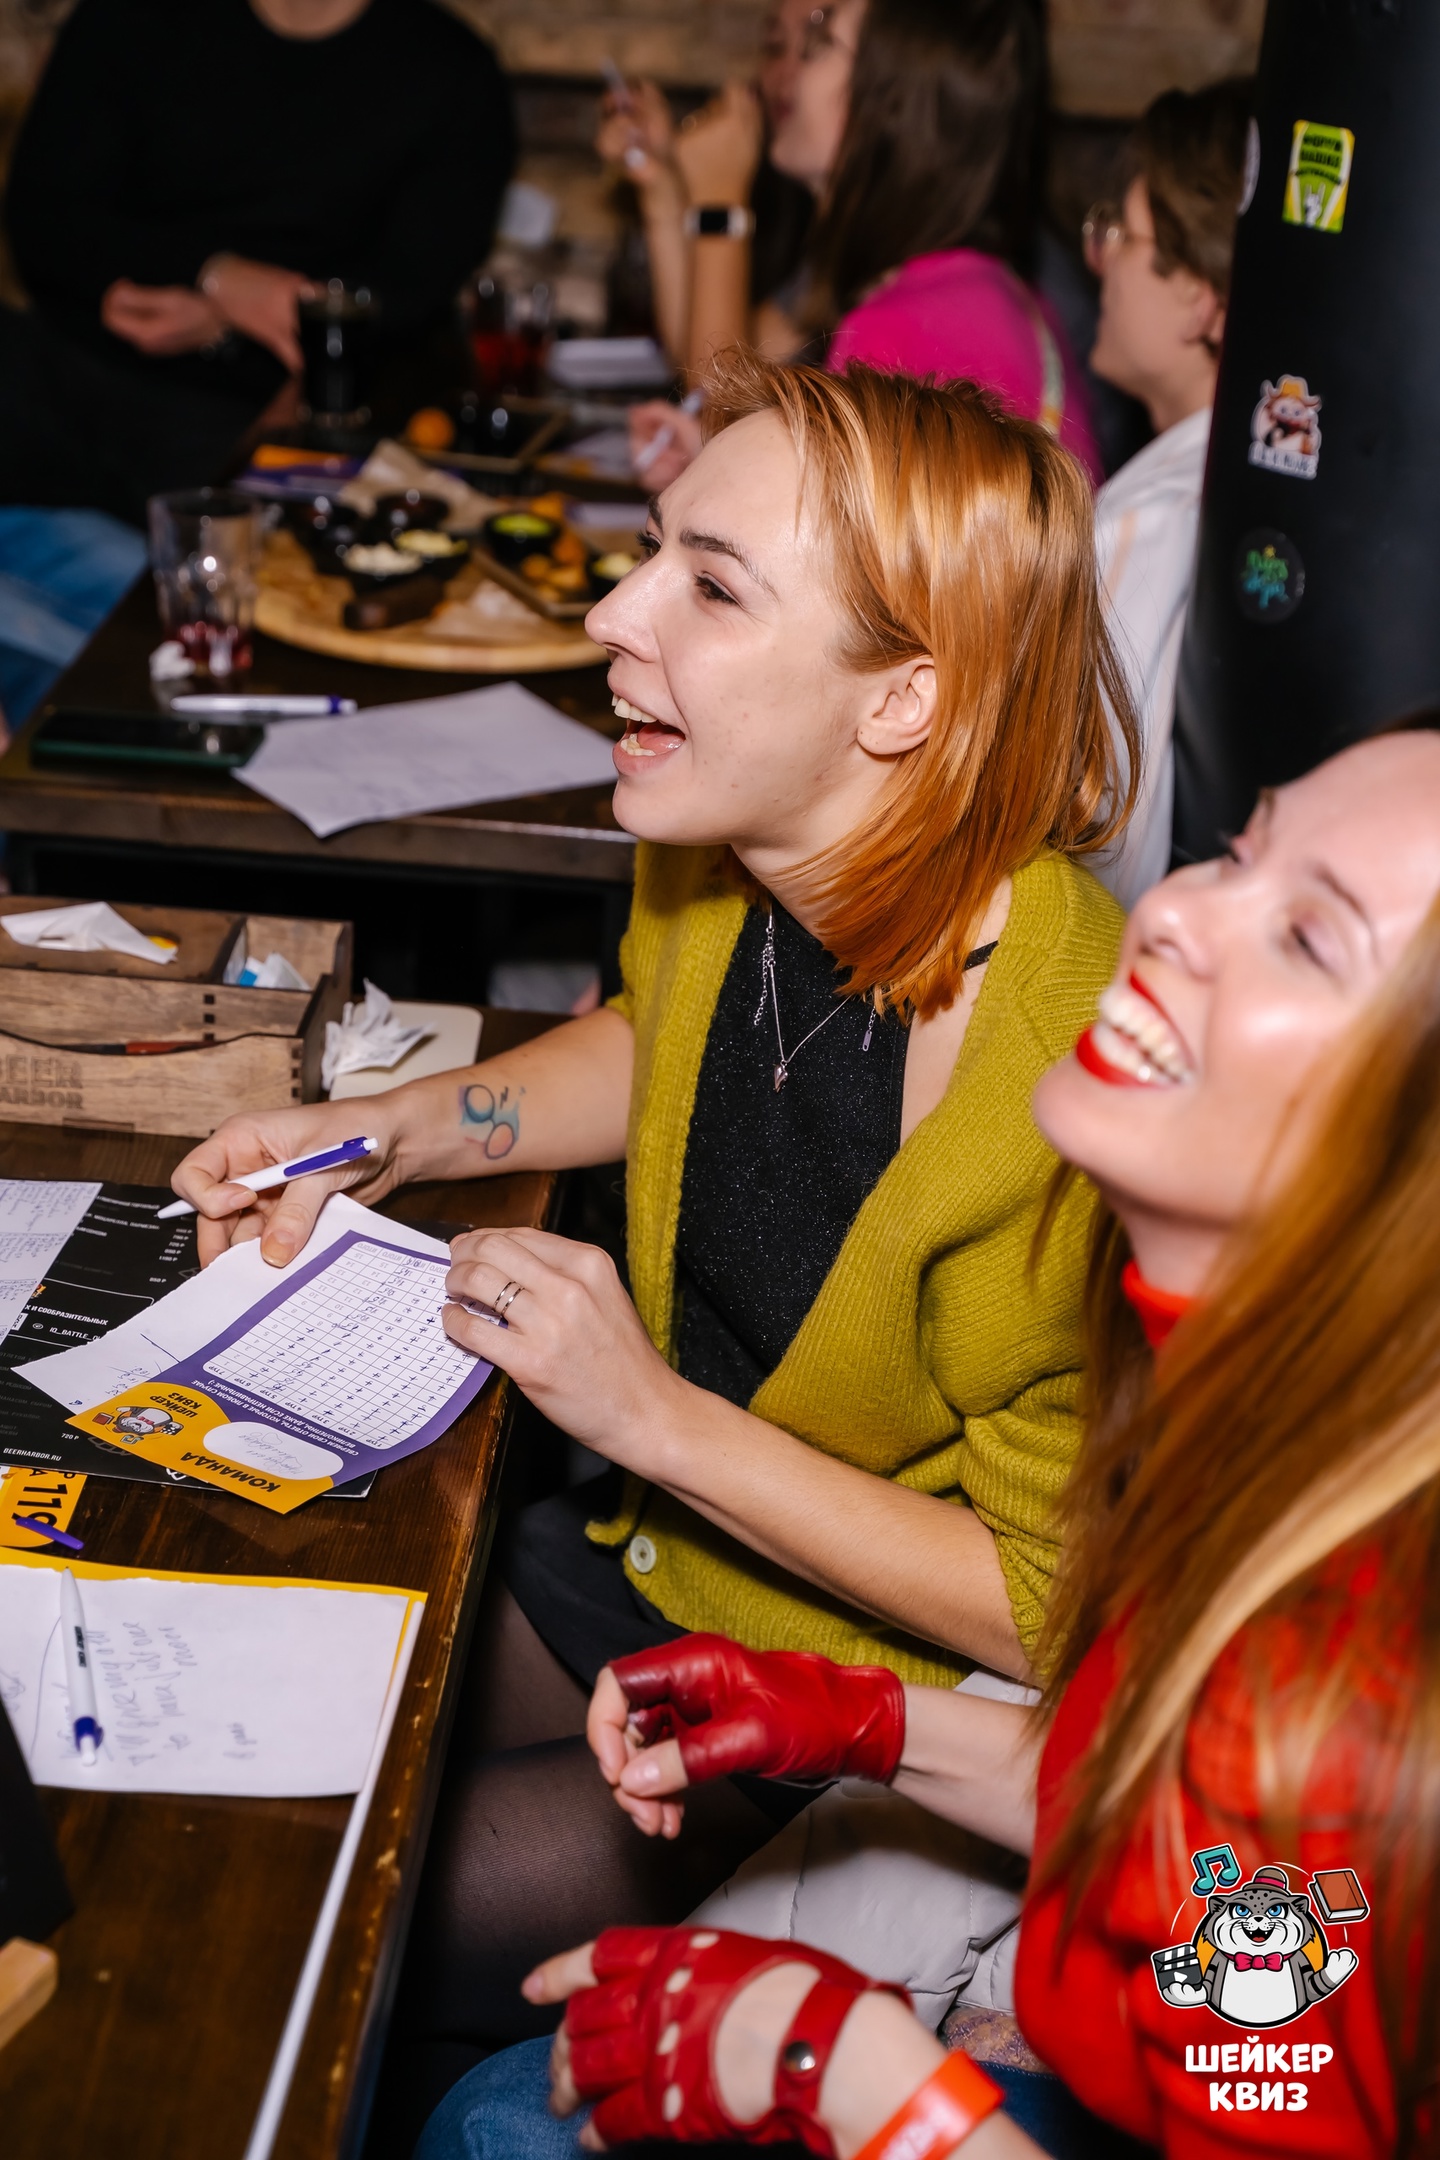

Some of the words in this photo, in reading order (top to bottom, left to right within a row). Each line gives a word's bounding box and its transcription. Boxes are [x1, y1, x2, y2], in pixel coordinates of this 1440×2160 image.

[0, 1054, 83, 1089] EER
[38, 1307, 108, 1326] СООБРАЗИТЕЛЬНЫХ
[191, 1380, 218, 1394] СЛУЧАЕ
[234, 1378, 246, 1386] ТУР
[168, 1392, 202, 1410] КВИЗ
[214, 1382, 267, 1410] НЕПРАВИЛЬНЫЕ
[216, 1391, 244, 1406] ЛЮБОМ
[150, 1395, 198, 1418] ШЕЙКЕР
[265, 1406, 284, 1417] ЕСЛИ
[248, 1406, 281, 1423] КОТОРЫЕ
[282, 1414, 306, 1426] ДАЖЕ
[312, 1414, 324, 1422] ТУР
[280, 1420, 309, 1436] ОТВЕТЫ,
[338, 1426, 350, 1434] ТУР
[304, 1423, 356, 1449] ВЕЛИКОЛЕПНЫ,
[308, 1432, 328, 1443] СВОИ
[3, 1448, 62, 1462] BEERHARBOR.RU
[326, 1441, 359, 1456] СВЕРЯЕМ
[180, 1452, 281, 1492] КОМАНДА
